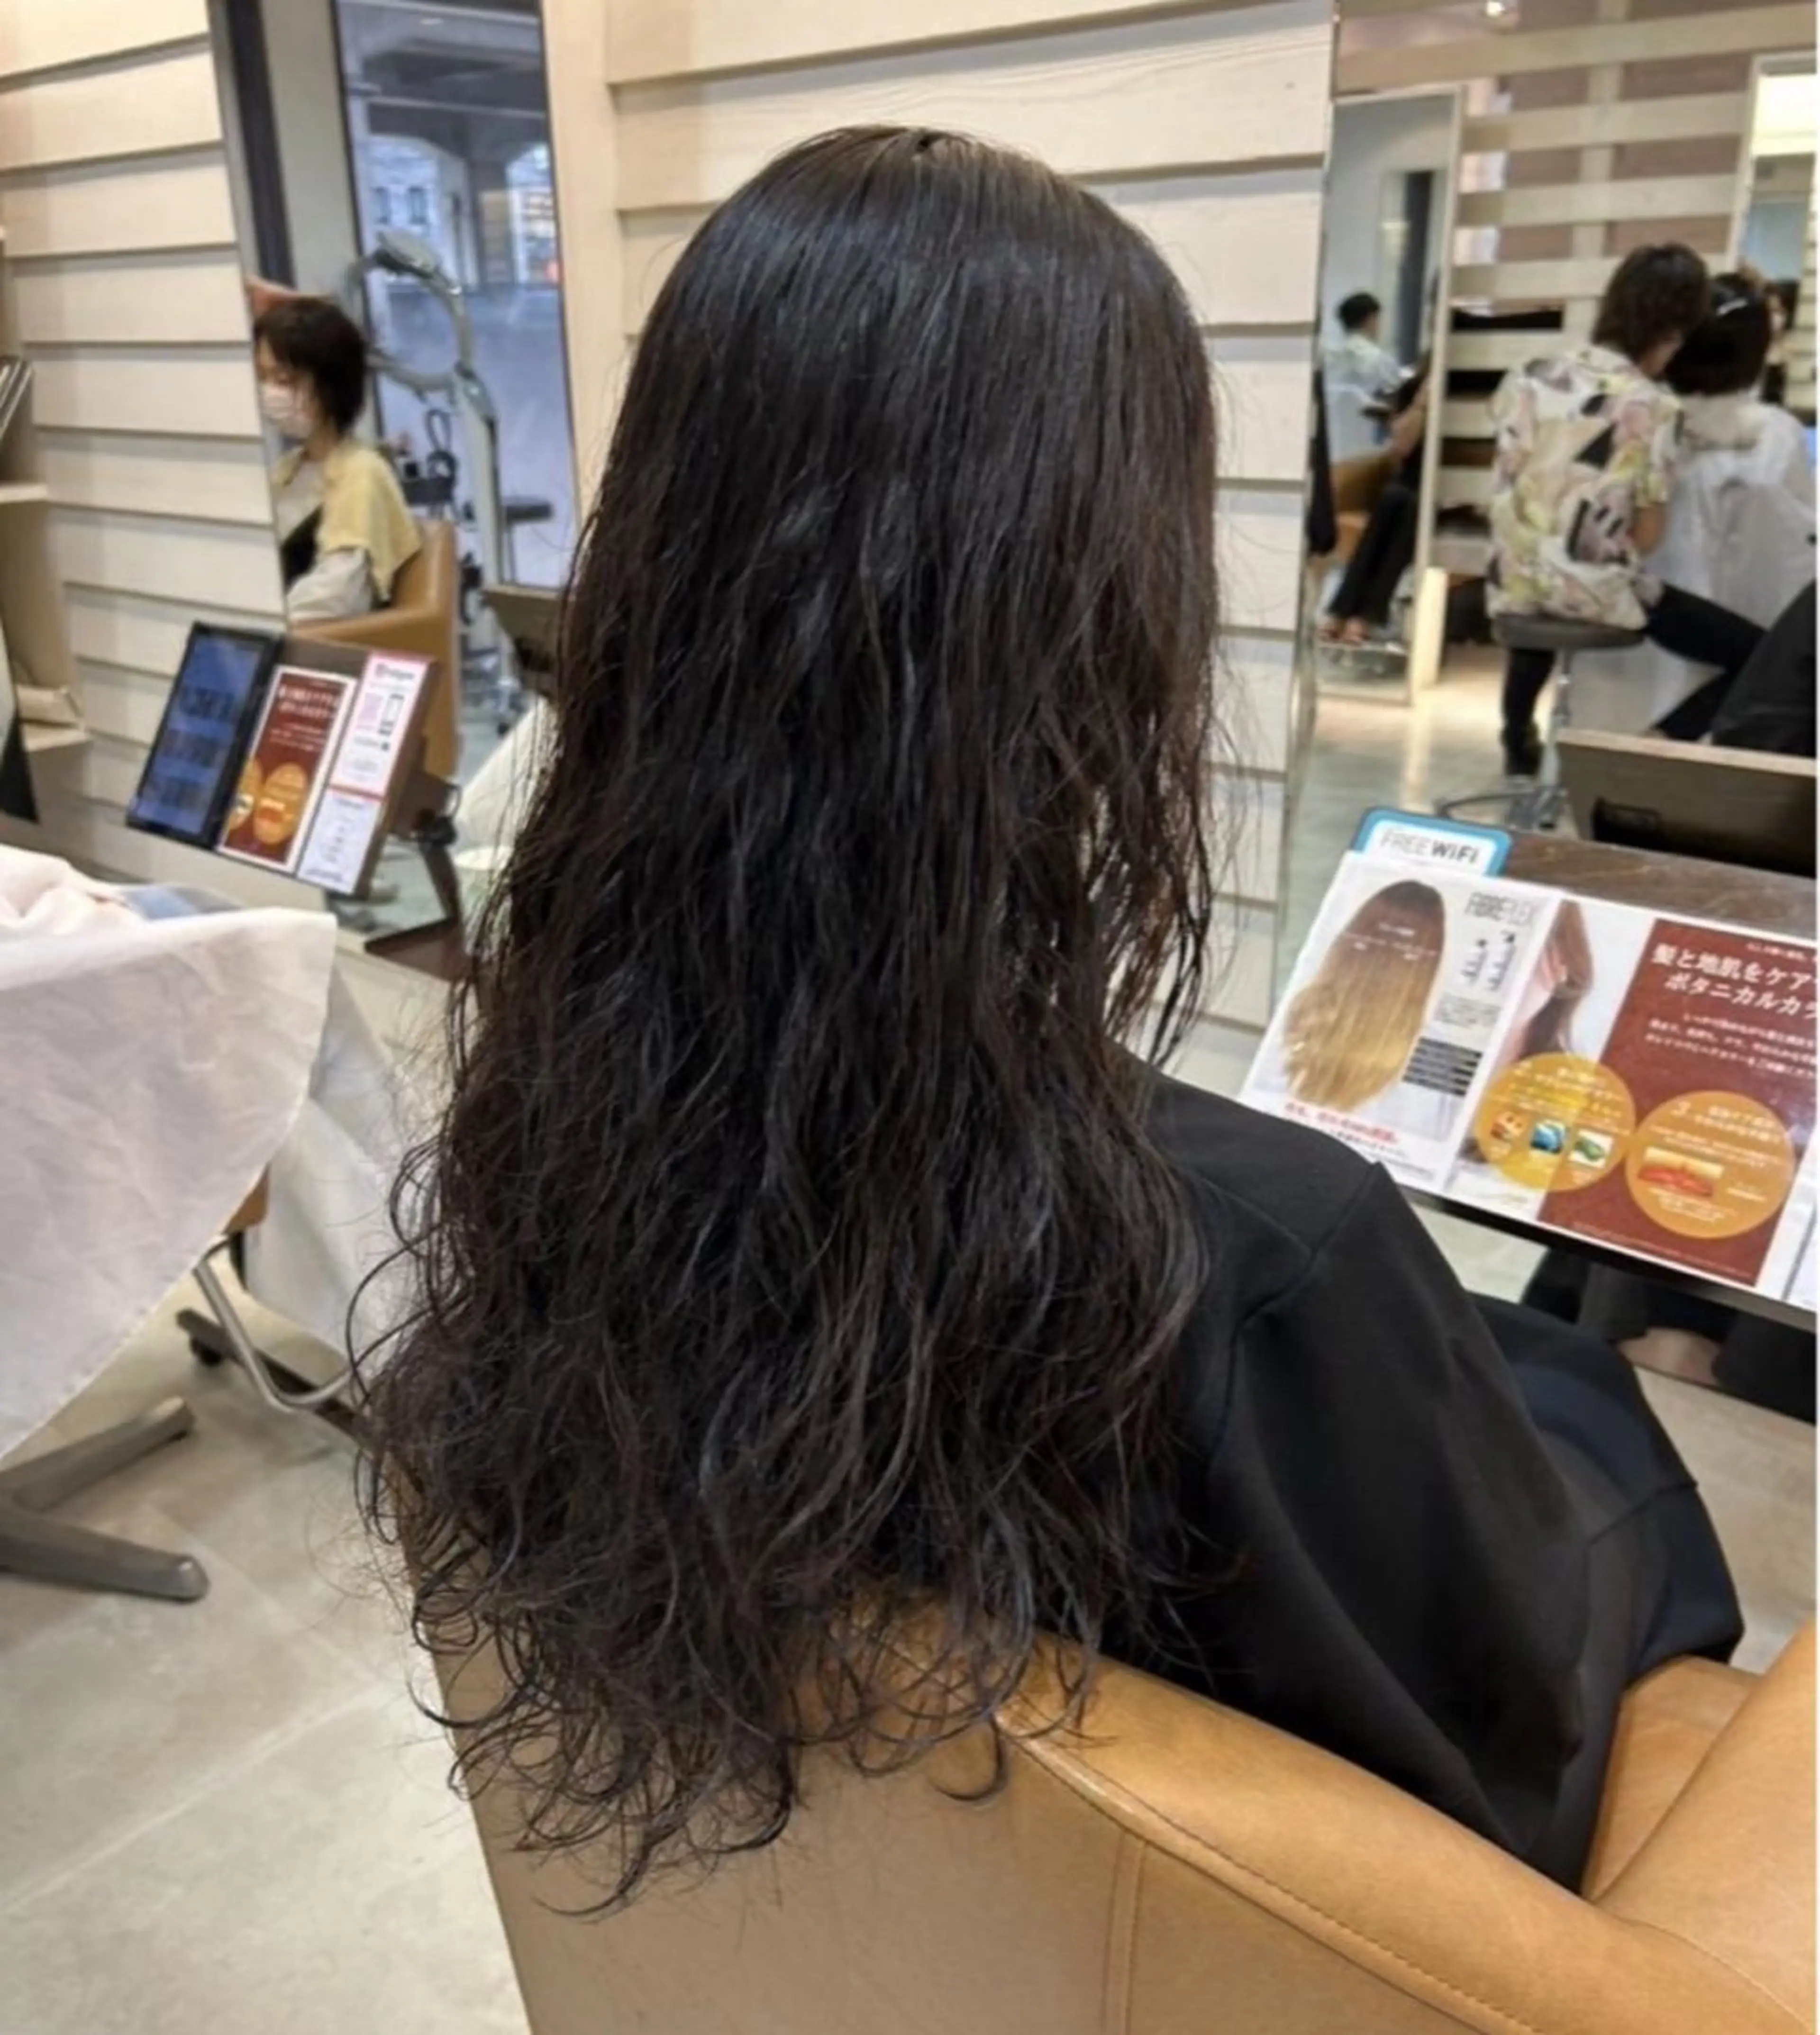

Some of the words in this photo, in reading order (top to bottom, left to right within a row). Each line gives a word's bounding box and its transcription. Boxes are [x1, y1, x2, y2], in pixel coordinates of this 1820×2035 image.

[1379, 827, 1430, 856] FREE
[1650, 942, 1816, 991] 髪と地肌をケア
